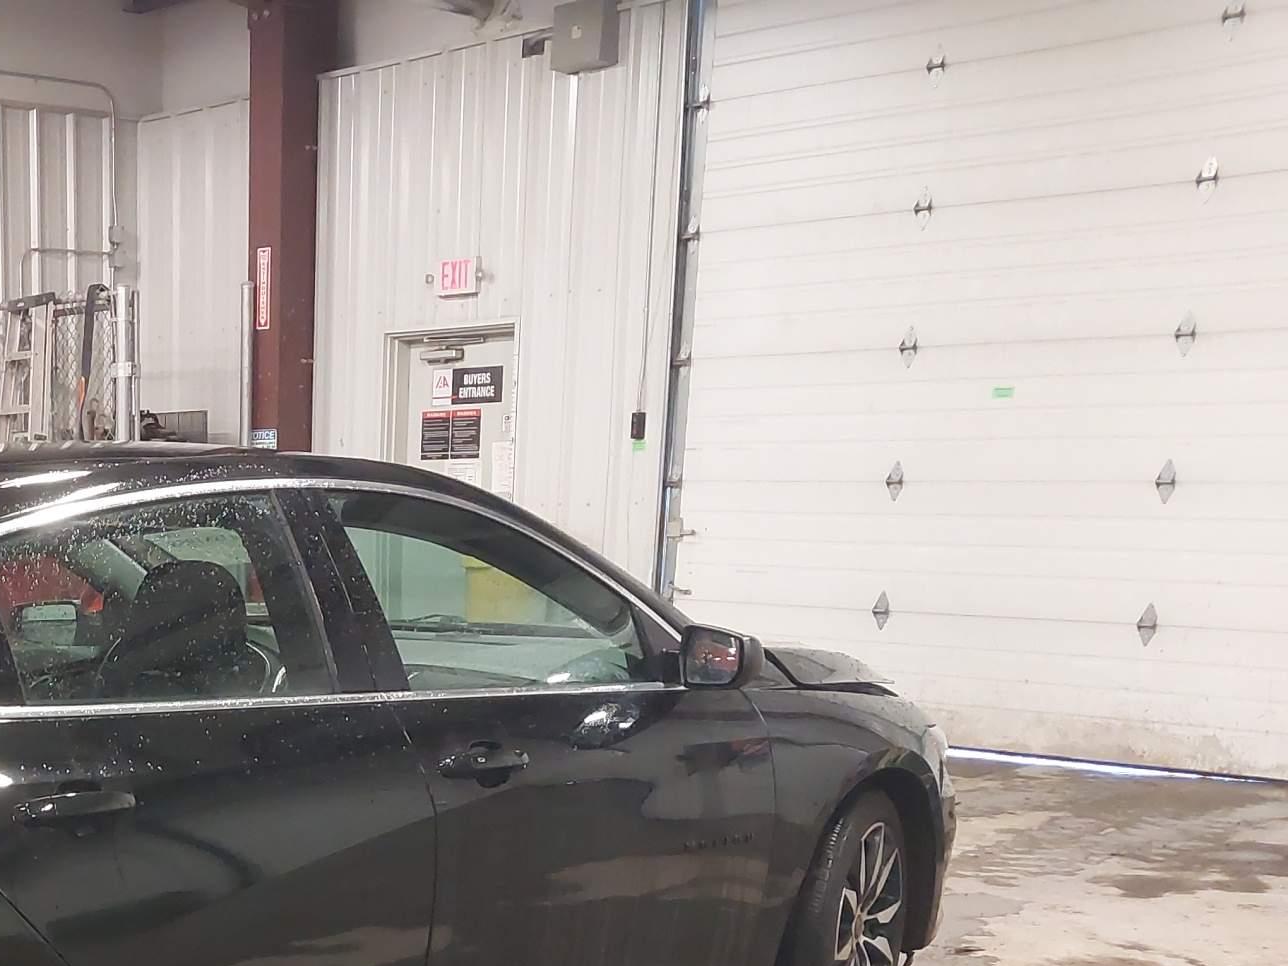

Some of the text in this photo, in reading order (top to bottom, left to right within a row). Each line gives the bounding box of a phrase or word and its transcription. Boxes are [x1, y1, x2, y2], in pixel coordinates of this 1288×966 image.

[441, 260, 470, 290] EXIT
[464, 373, 491, 385] BUYERS
[459, 386, 495, 398] ENTRANCE
[252, 430, 275, 440] OTICE
